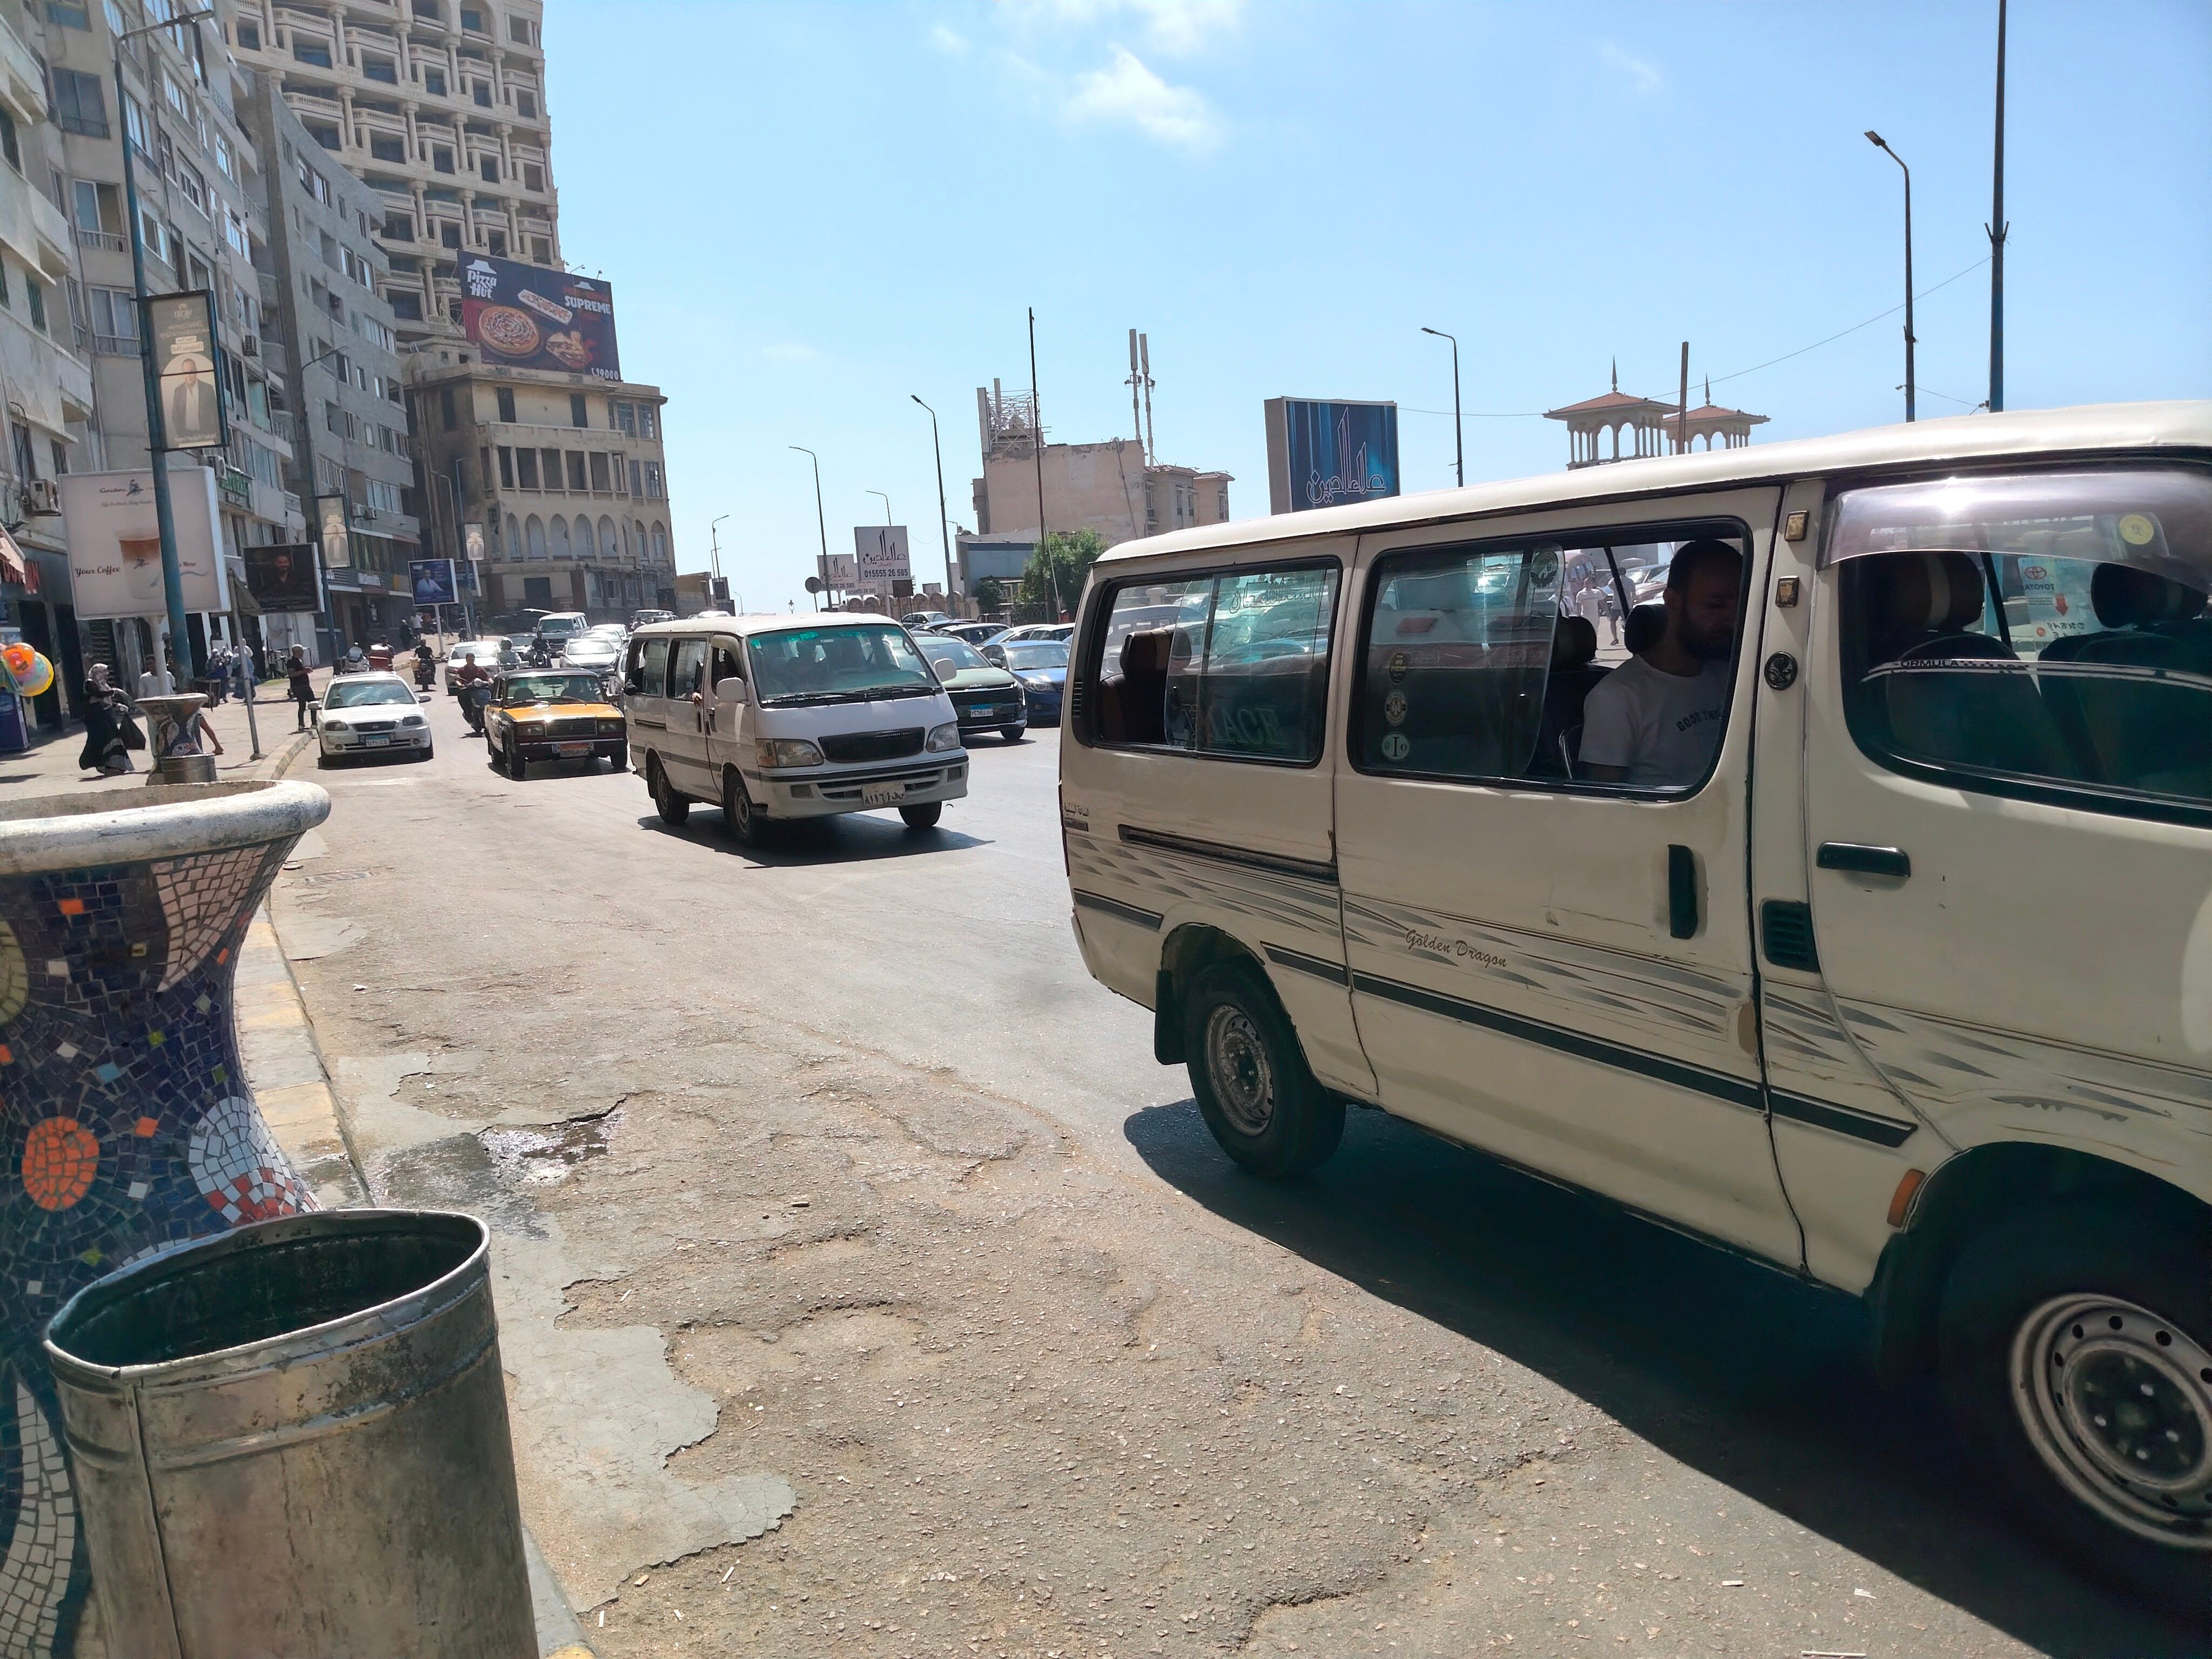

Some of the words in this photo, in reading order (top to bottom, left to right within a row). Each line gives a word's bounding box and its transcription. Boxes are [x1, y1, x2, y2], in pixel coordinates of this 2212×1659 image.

[467, 270, 497, 289] Pizza
[469, 284, 493, 299] Hut
[564, 295, 611, 314] SUPREME
[596, 368, 618, 380] 19000
[75, 568, 95, 577] Your
[97, 565, 120, 575] Coffee
[1406, 929, 1451, 953] Golden
[1455, 940, 1507, 968] Dragon
